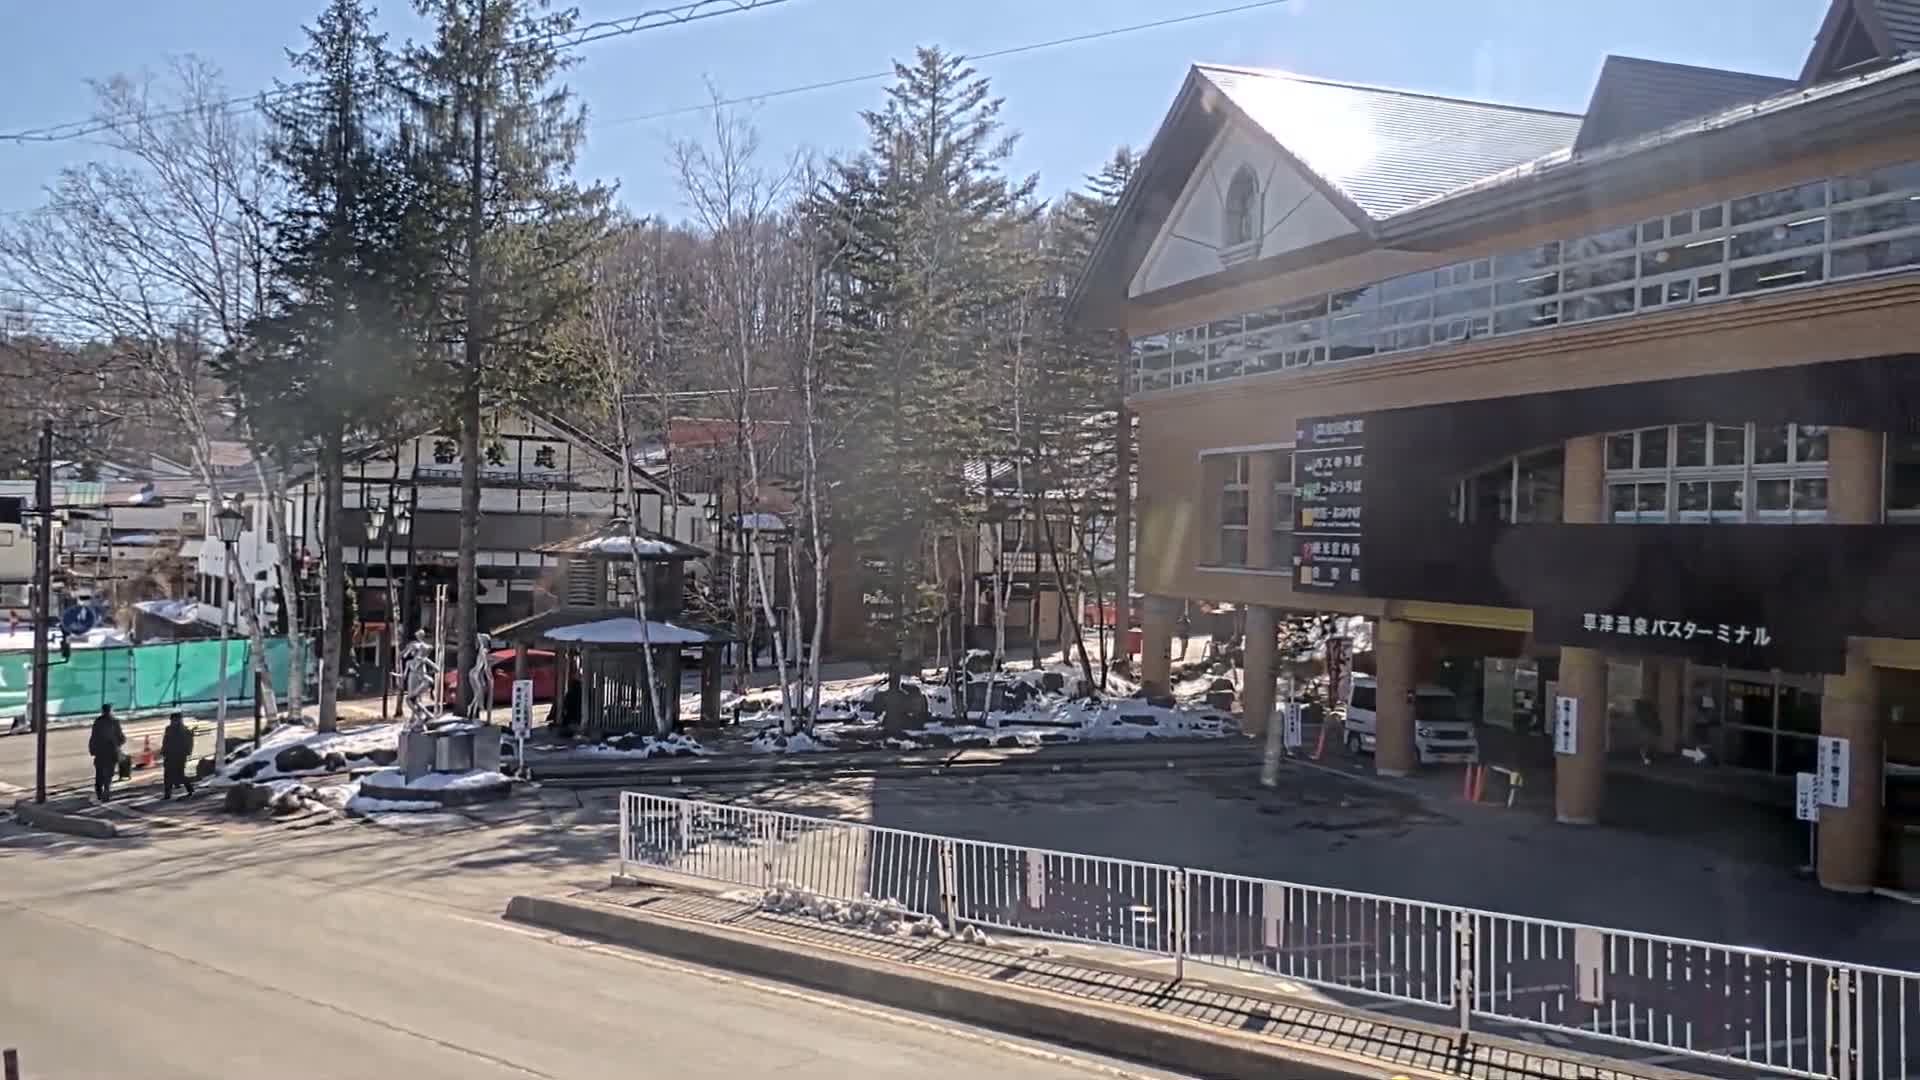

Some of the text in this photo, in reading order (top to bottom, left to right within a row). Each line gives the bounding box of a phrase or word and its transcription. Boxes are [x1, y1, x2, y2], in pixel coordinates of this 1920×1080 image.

[1583, 613, 1772, 647] 草津温泉バスターミナル
